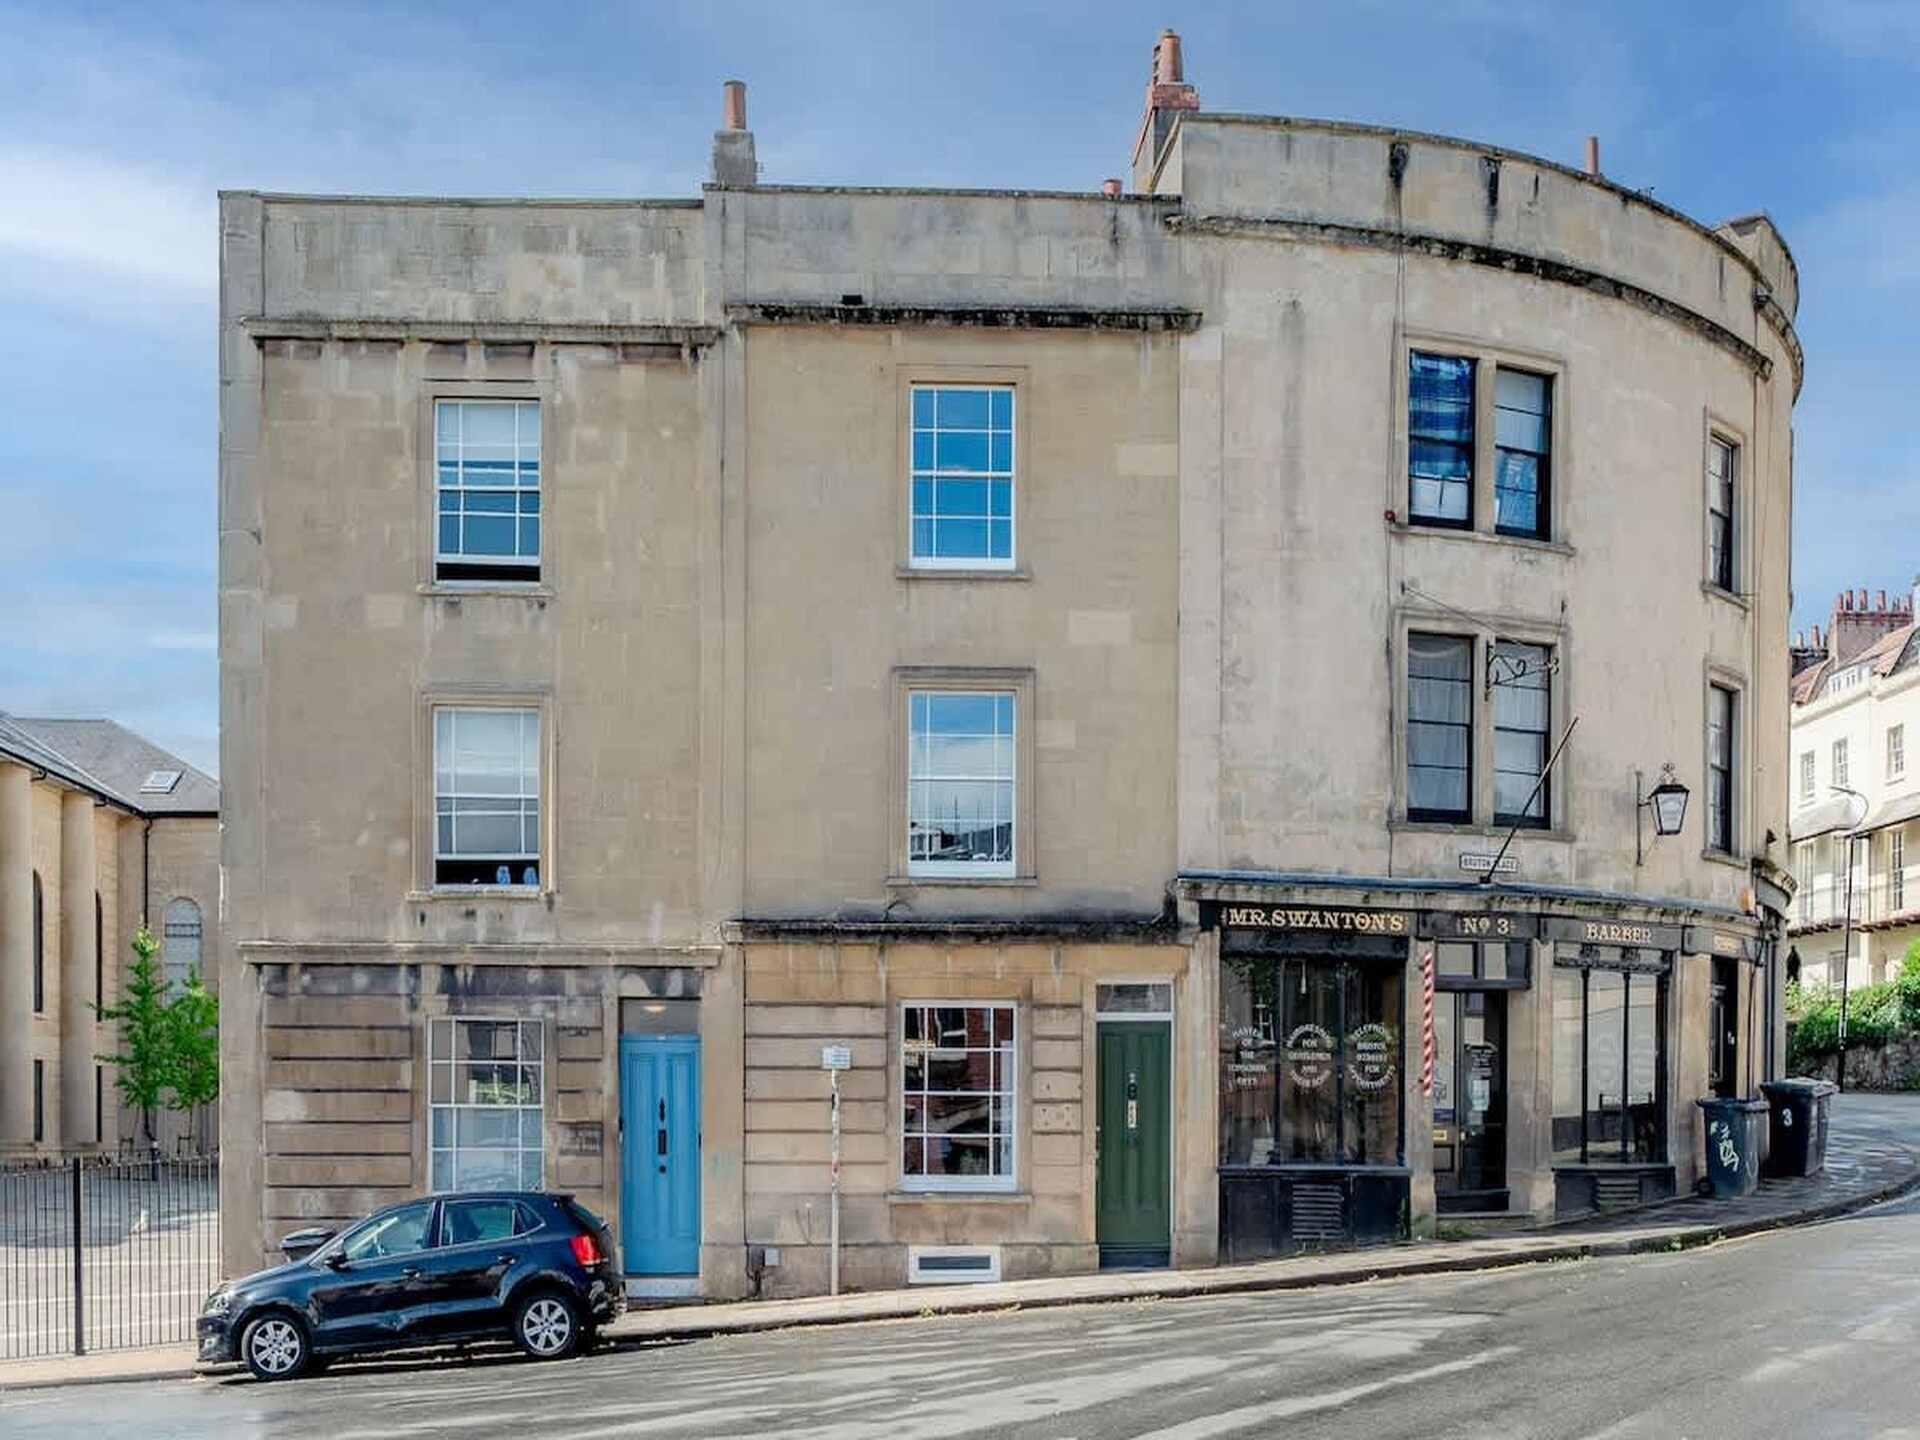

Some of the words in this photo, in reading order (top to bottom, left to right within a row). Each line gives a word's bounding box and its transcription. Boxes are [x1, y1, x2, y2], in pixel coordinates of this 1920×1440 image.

[1497, 917, 1510, 935] 3
[1586, 922, 1652, 944] BARBER
[1782, 1107, 1793, 1127] 3
